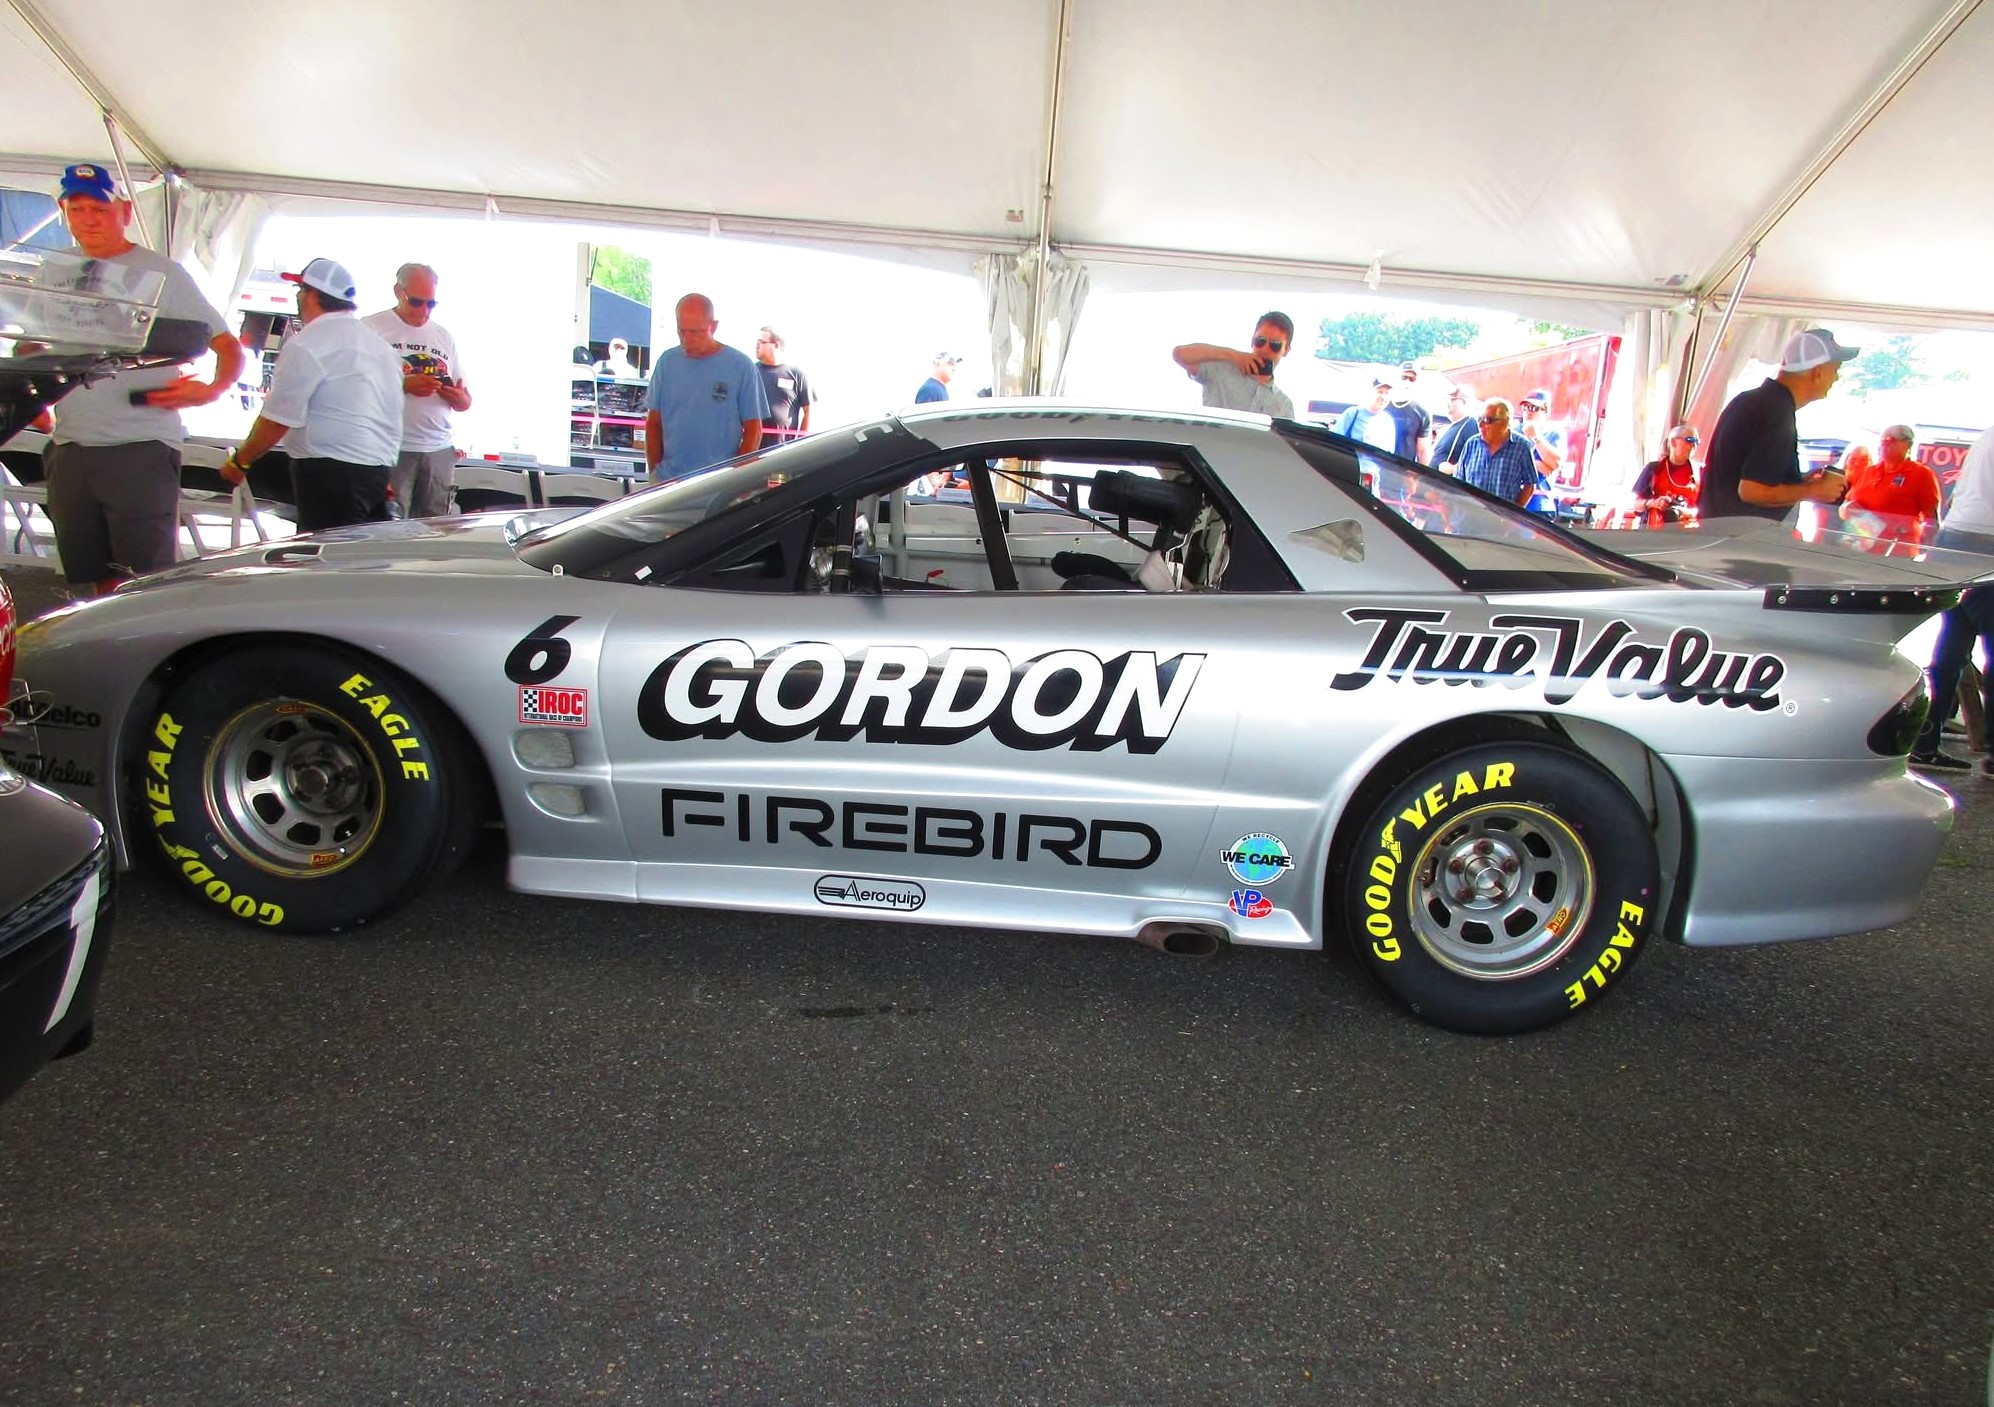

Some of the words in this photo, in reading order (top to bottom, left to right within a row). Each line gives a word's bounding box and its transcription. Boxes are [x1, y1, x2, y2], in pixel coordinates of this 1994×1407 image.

[504, 614, 582, 686] 6
[338, 673, 430, 782] EAGLE
[538, 690, 583, 716] IROC
[638, 639, 1208, 755] GORDON
[661, 788, 1162, 870] FIREBIRD
[1222, 850, 1247, 864] WE
[841, 880, 922, 909] Aeroquip
[1232, 888, 1263, 918] VP
[1564, 900, 1645, 1010] EAGLE
